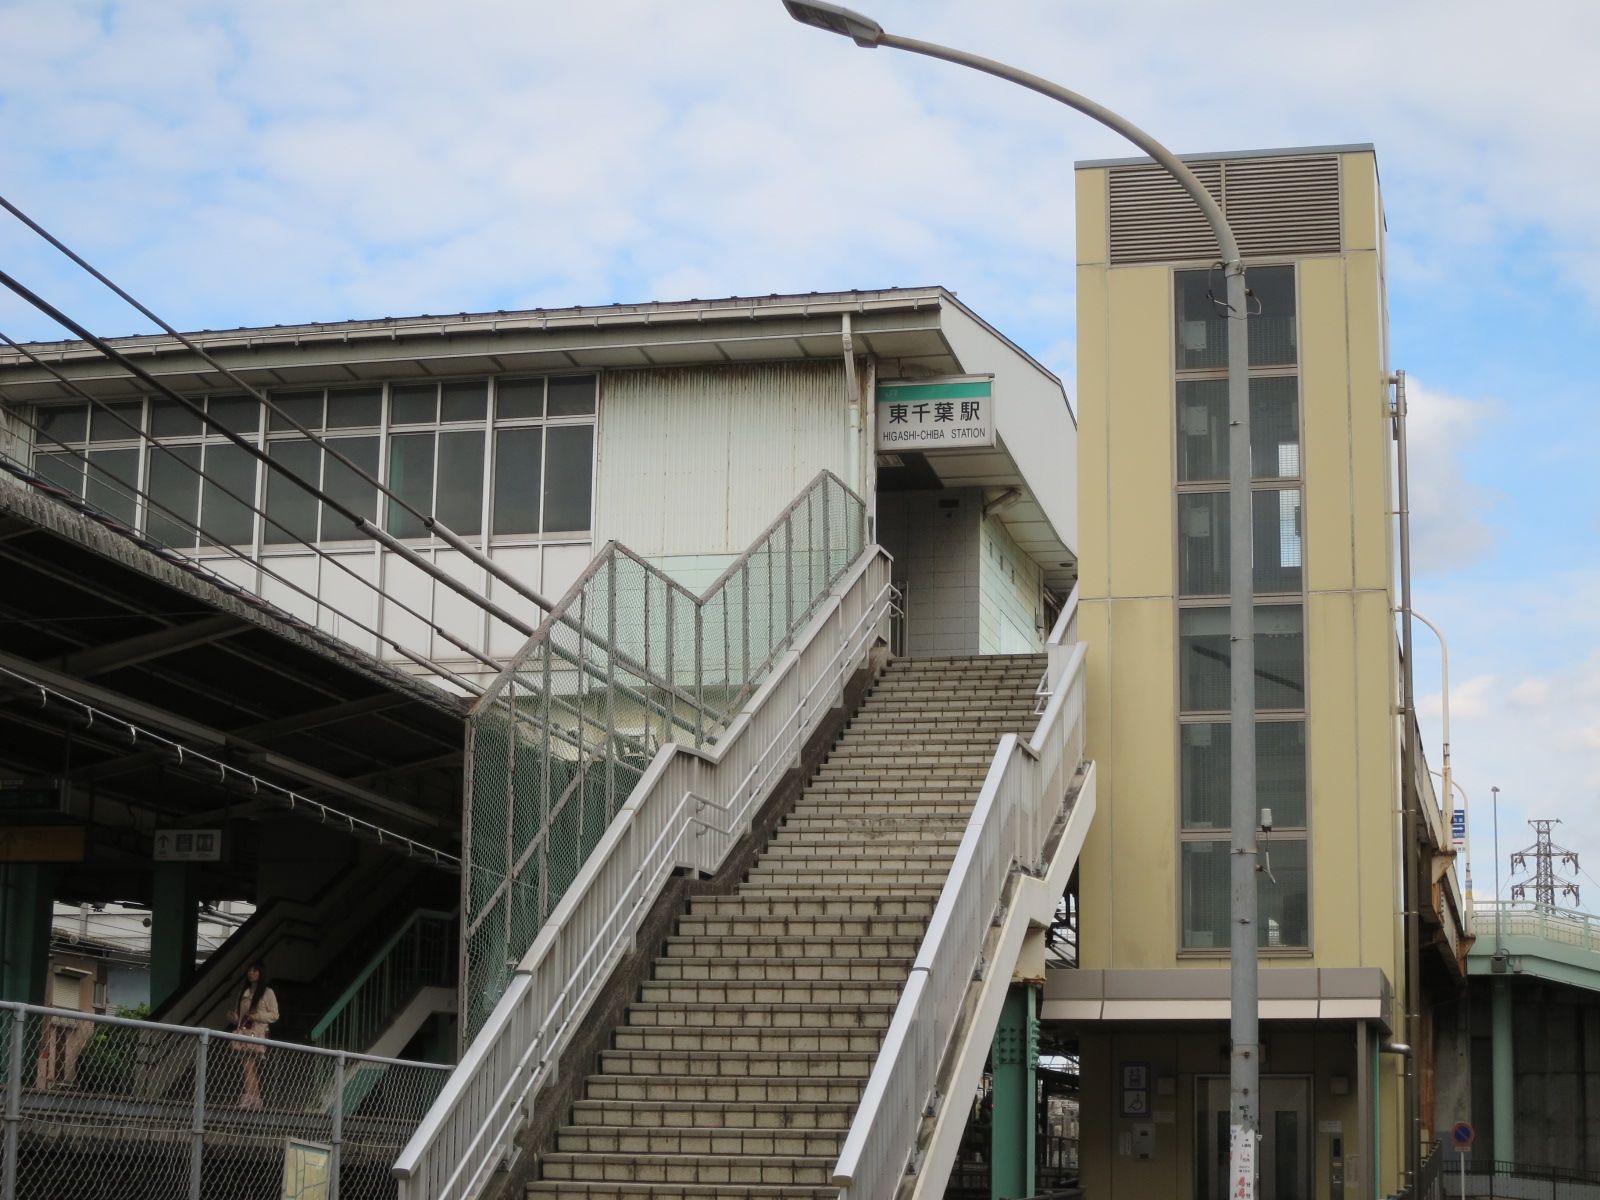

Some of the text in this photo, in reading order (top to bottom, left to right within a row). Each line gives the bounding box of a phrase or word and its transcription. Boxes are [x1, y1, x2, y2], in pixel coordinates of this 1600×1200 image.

[889, 401, 980, 424] 東千葉駅
[883, 427, 986, 442] HIGASHI-CHIBA STATION
